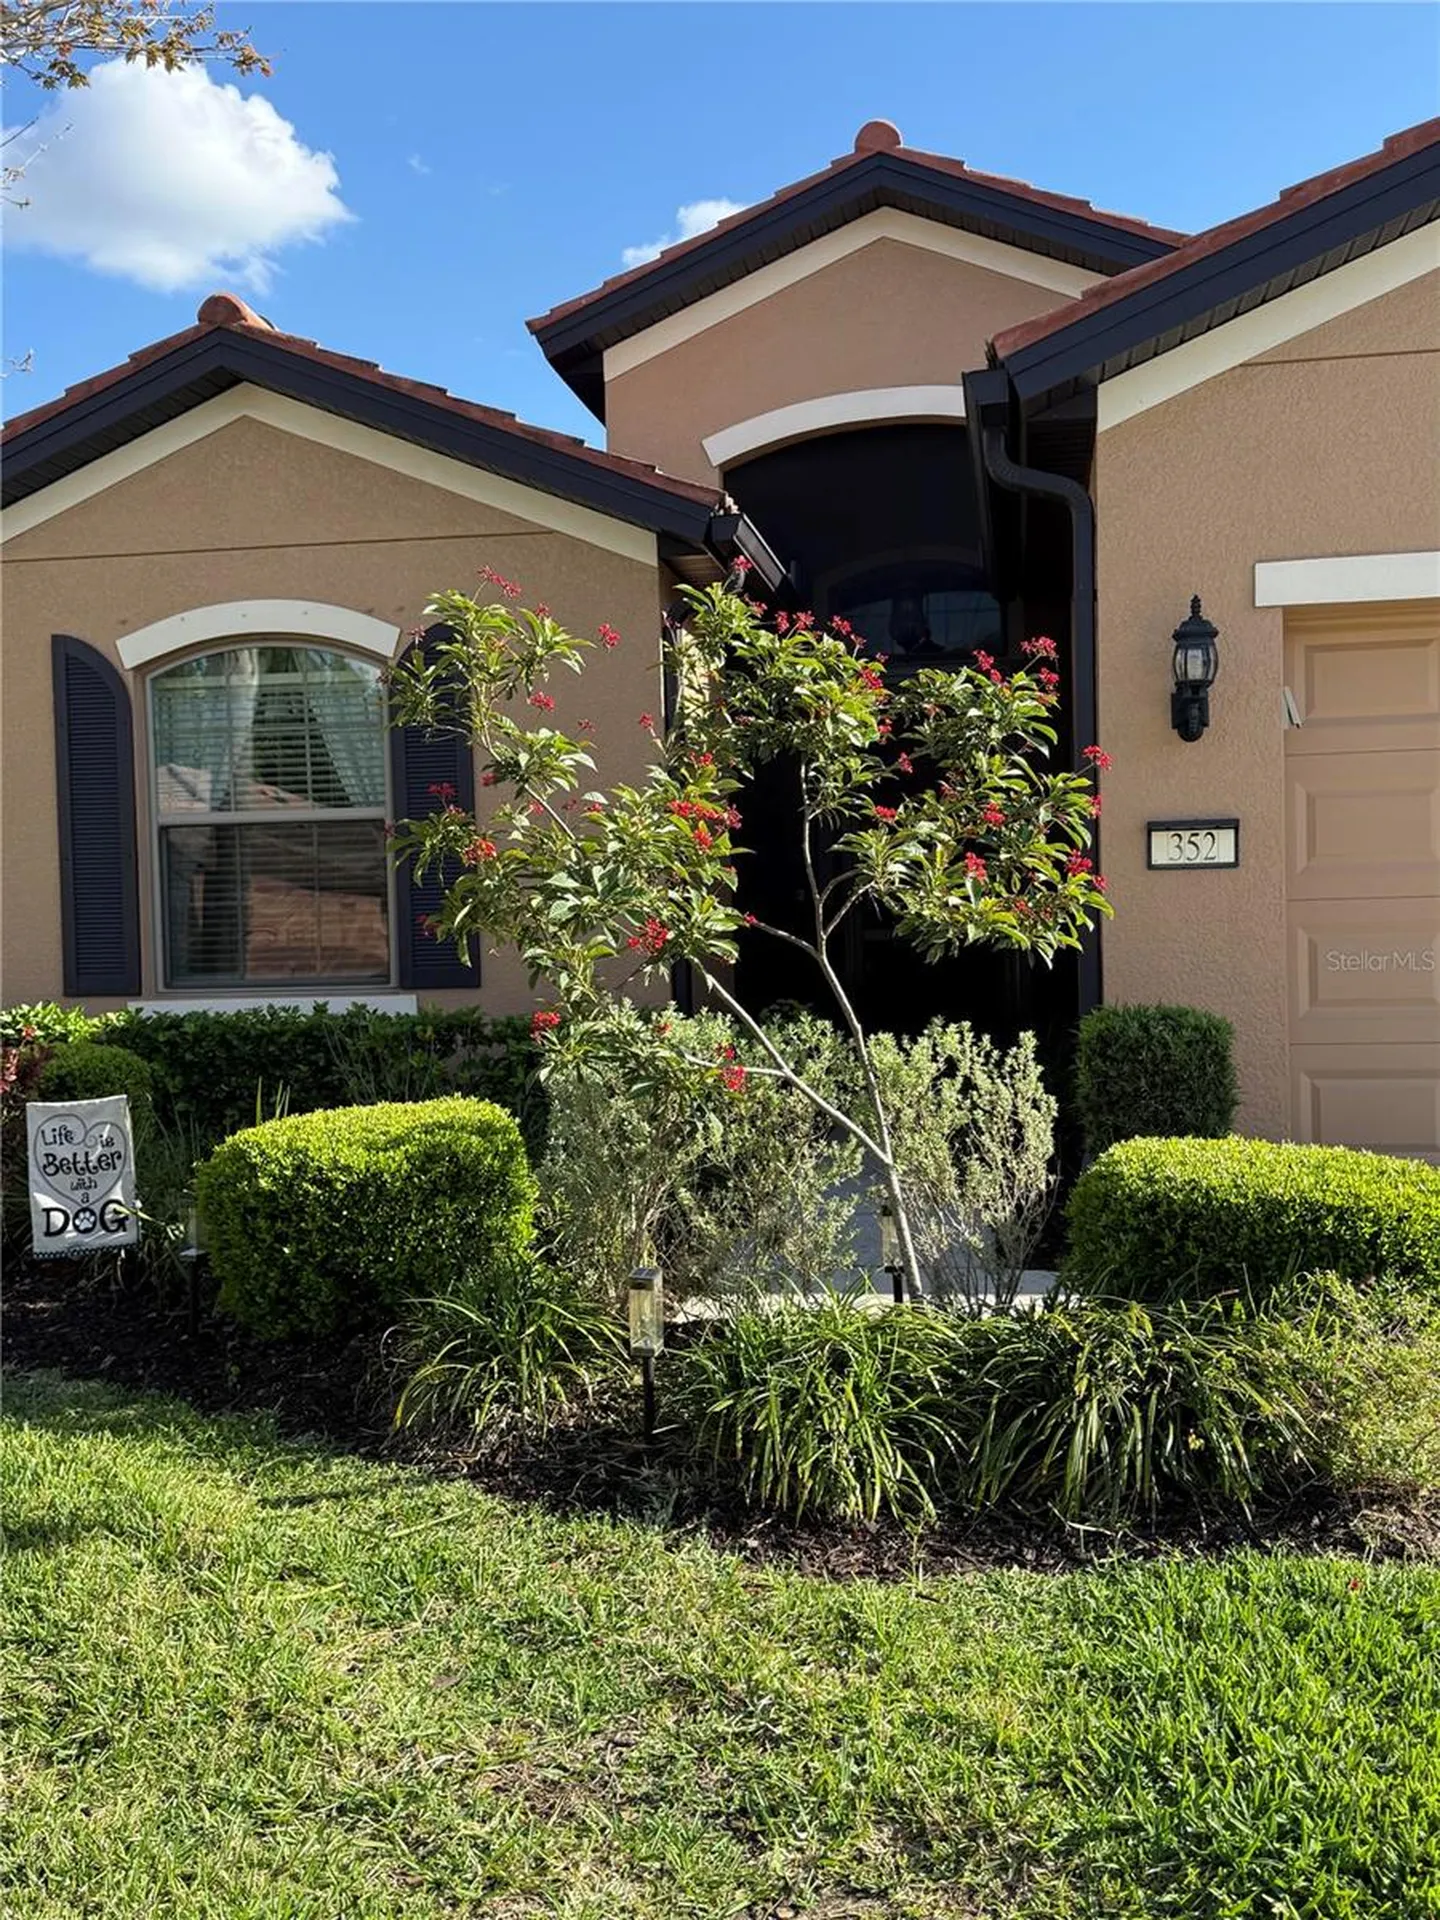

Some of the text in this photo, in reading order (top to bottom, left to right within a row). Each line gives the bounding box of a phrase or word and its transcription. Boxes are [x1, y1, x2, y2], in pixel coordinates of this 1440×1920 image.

[1168, 831, 1217, 862] 352
[41, 1125, 115, 1148] Life is
[42, 1150, 122, 1176] Better
[70, 1178, 97, 1191] with
[81, 1193, 90, 1204] a
